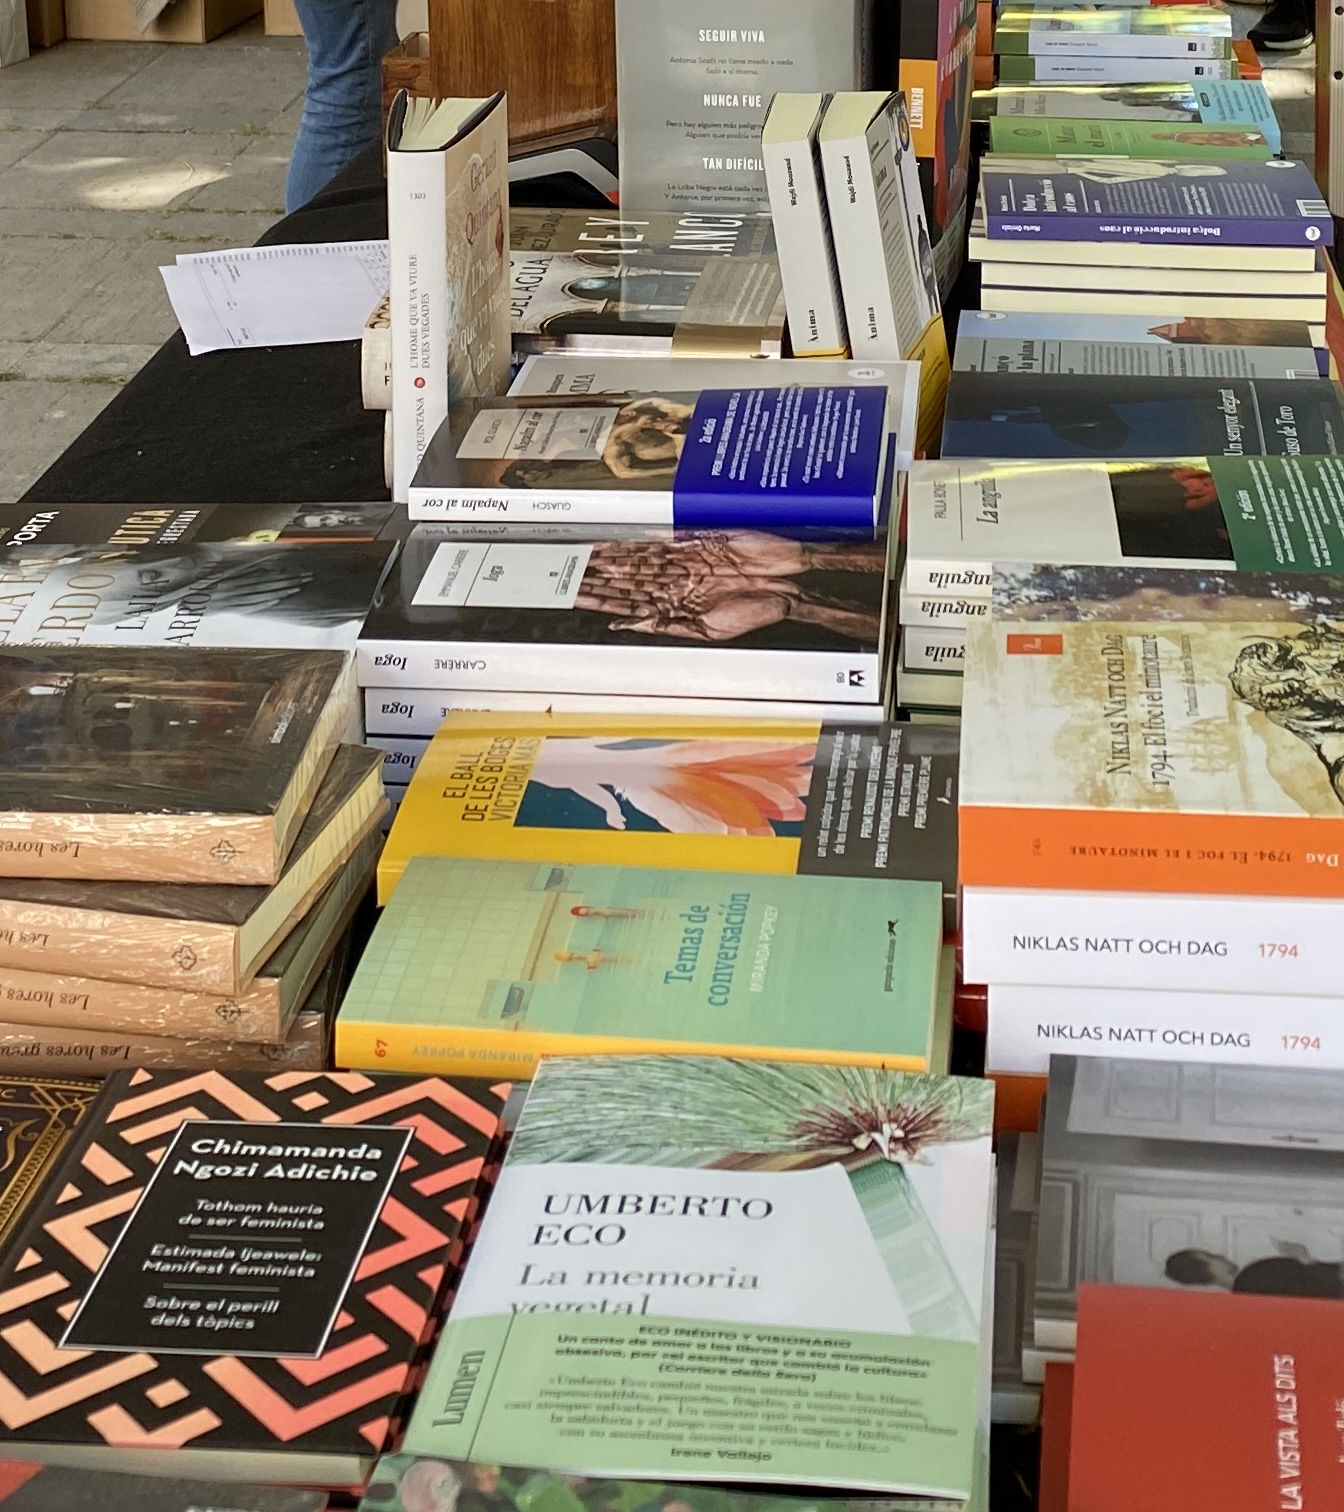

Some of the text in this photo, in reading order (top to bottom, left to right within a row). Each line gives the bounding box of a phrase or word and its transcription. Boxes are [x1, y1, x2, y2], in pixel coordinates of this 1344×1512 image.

[698, 29, 765, 43] SEGUIR VIVA
[703, 94, 762, 107] NUNCA FUE
[702, 155, 763, 171] TAN DIFÍCIL
[409, 254, 419, 369] L'HOME QUE VIURE
[421, 293, 430, 369] DUES VEGADES
[416, 396, 425, 452] QUINTANA
[422, 498, 509, 512] Napalm al cor
[532, 501, 572, 510] GUASCH
[928, 570, 992, 589] anguila
[921, 600, 986, 620] anguila
[374, 655, 407, 670] Ioga
[380, 703, 414, 719] Ioga
[442, 752, 484, 798] EL BALL
[461, 736, 517, 822] DE LES BOGES
[487, 763, 532, 821] VICTORIA
[49, 843, 81, 858] Les
[19, 933, 51, 947] Les
[663, 904, 710, 985] Temas de
[708, 892, 751, 1007] conversación
[1011, 932, 1229, 958] NIKLAS NATT OCH DAG
[1257, 941, 1299, 959] 1794
[7, 989, 56, 1008] hores
[60, 993, 92, 1011] Les
[1035, 1023, 1252, 1050] NIKLAS NATT OCH DAG
[1280, 1033, 1322, 1051] 1794
[45, 1044, 94, 1061] hores
[99, 1045, 131, 1060] Les
[191, 1137, 384, 1162] Chimamanda
[173, 1159, 379, 1184] Ngozi Adichie
[196, 1198, 325, 1215] Tothom hauria
[542, 1193, 775, 1221] UMBERTO
[237, 1214, 326, 1231] feminista
[527, 1223, 629, 1248] ECO
[150, 1243, 238, 1260] Estimada
[142, 1259, 316, 1279] Manifest feminista
[518, 1262, 763, 1290] La memoria
[143, 1296, 281, 1316] Sobre perill
[150, 1312, 257, 1332] dels tòpics
[639, 1323, 671, 1336] ECO
[432, 1348, 487, 1429] Lumen
[1272, 1354, 1303, 1510] LA VISTA ALS DITS
[670, 1447, 773, 1464] Irene Vallejo
